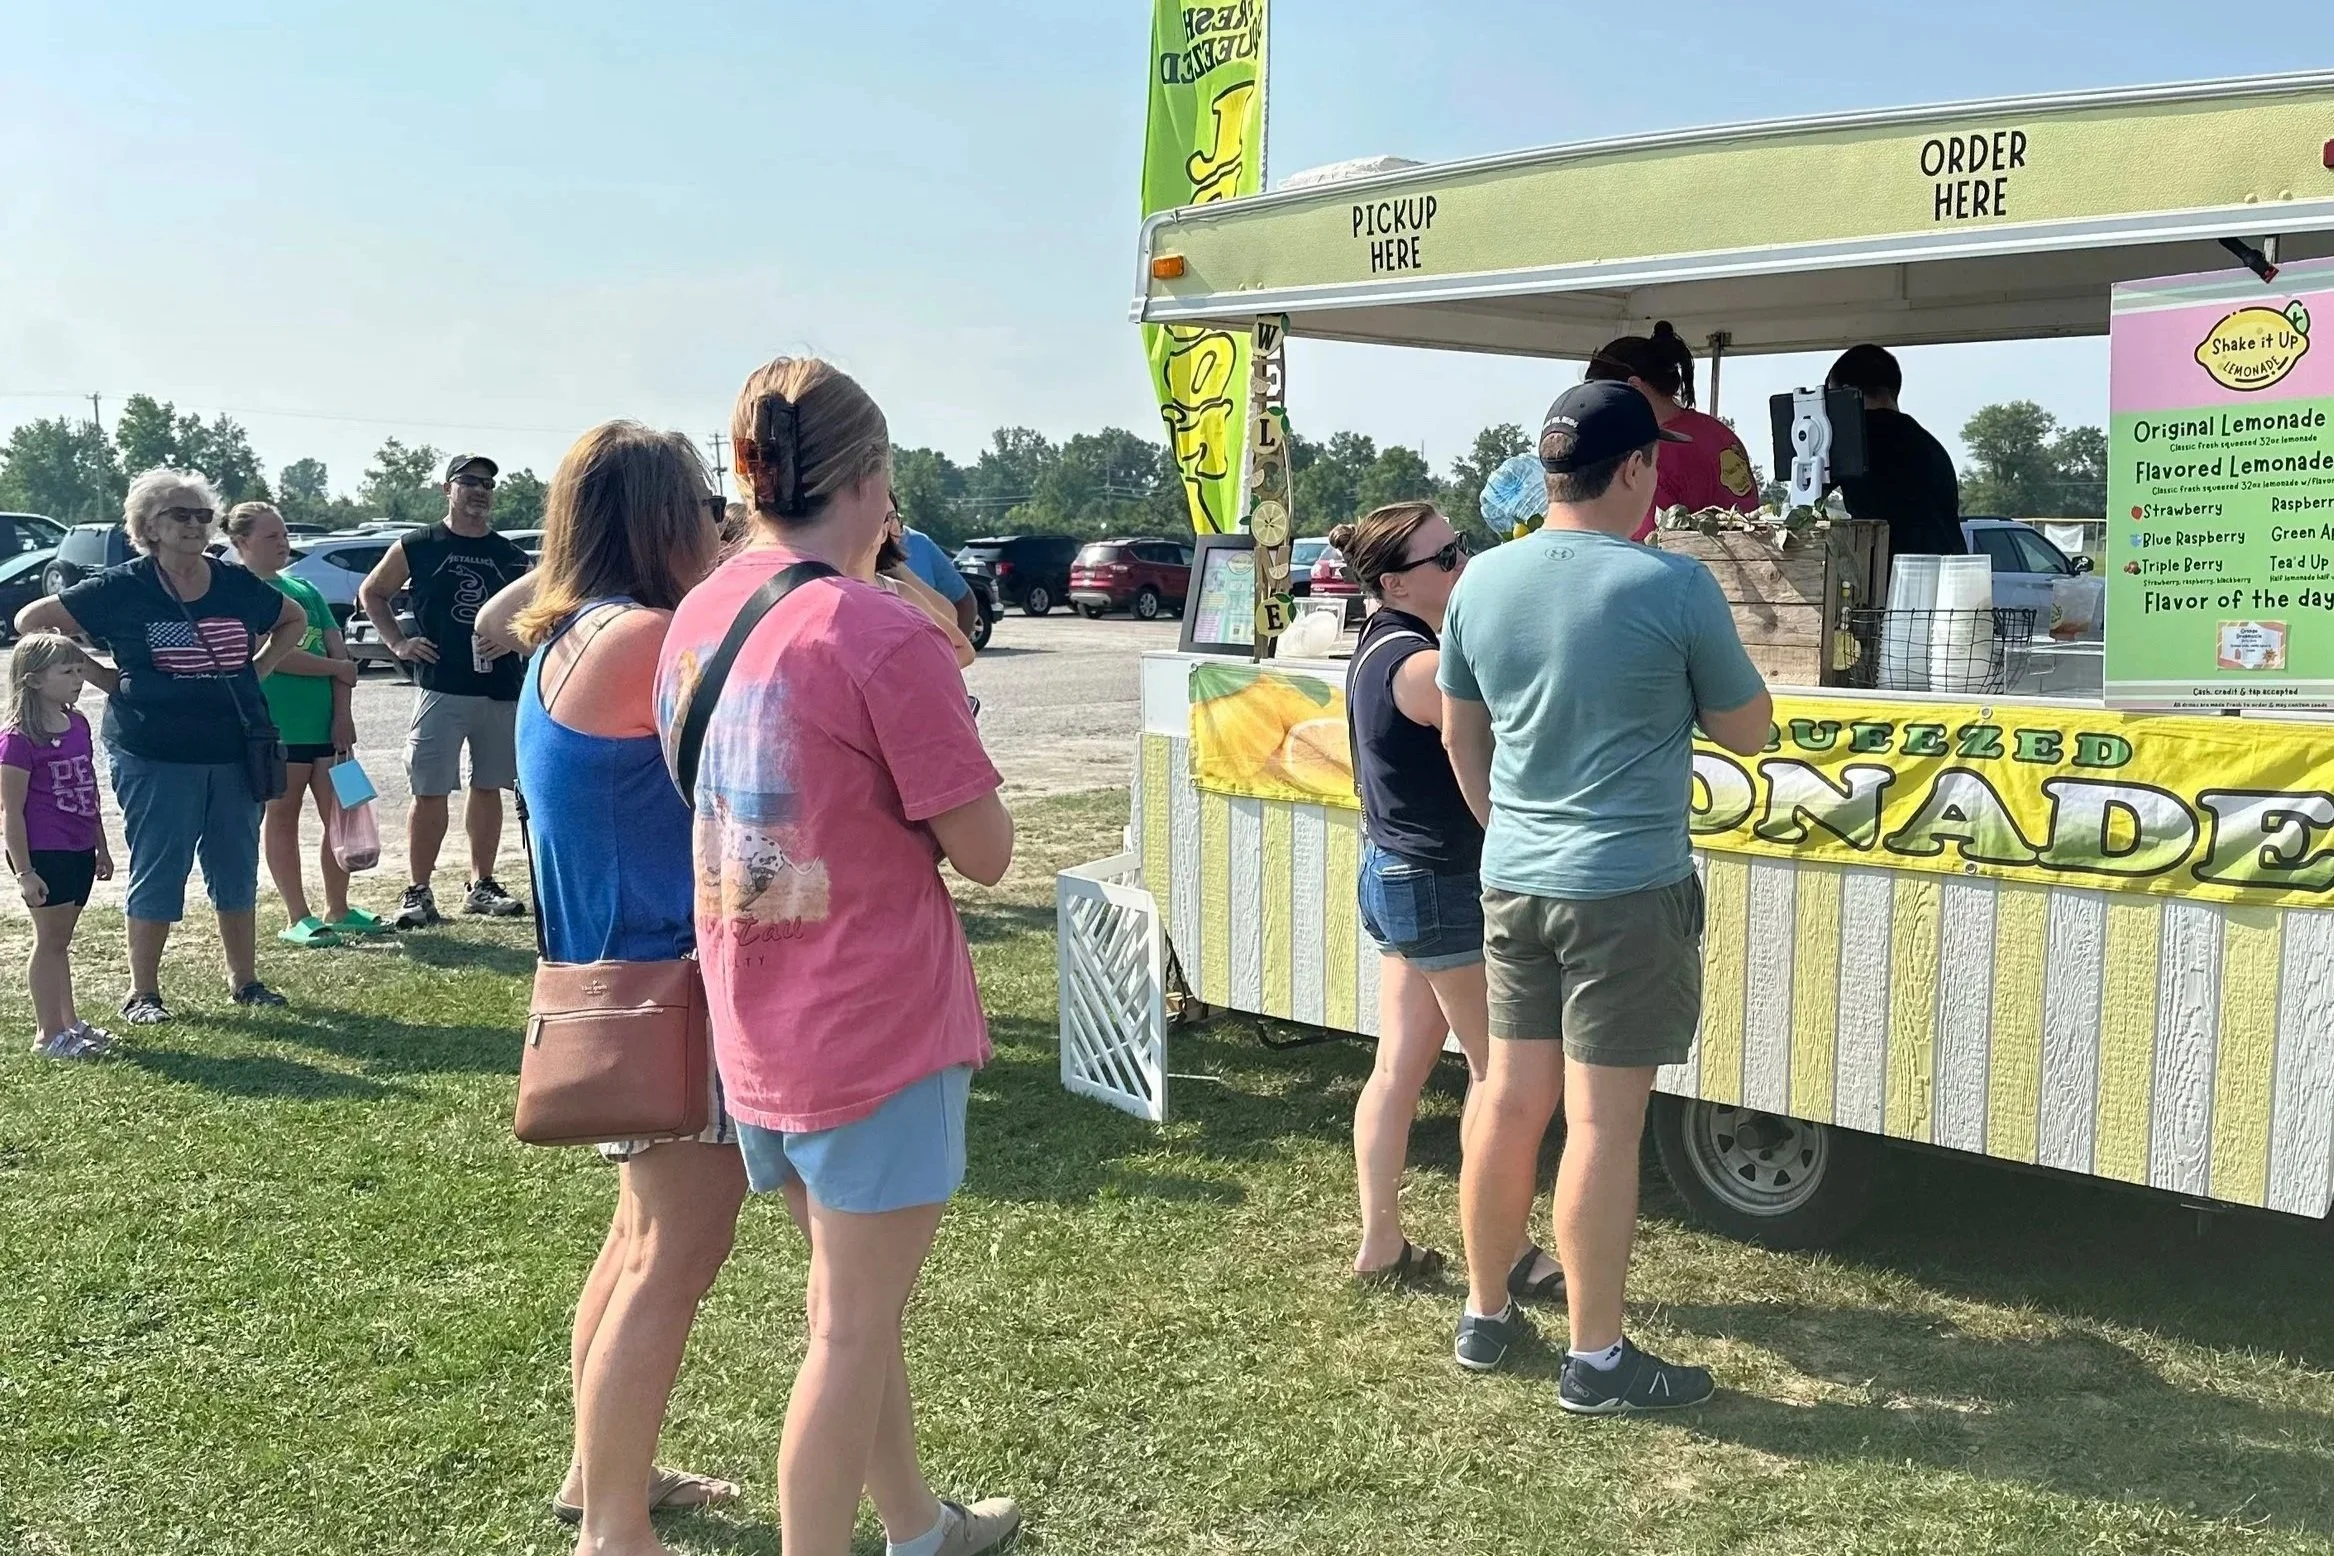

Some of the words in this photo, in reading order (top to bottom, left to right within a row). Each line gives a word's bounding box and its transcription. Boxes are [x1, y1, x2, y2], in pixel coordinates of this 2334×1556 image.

[1920, 130, 2027, 177] ORDER
[1935, 177, 2008, 222] HERE
[1353, 195, 1437, 239] PICKUP
[1371, 236, 1422, 273] HERE
[2212, 336, 2256, 355] Shake
[2261, 333, 2274, 349] it
[2223, 356, 2280, 377] LEMONADE
[2134, 416, 2214, 443] Original
[2221, 408, 2326, 437] Lemonade
[2170, 443, 2196, 452] Classic
[2198, 440, 2219, 450] fresh
[2220, 438, 2257, 449] squeezed
[2259, 437, 2279, 447] 32oz
[2281, 434, 2317, 444] lemonade
[2136, 457, 2222, 484] Flavored
[2229, 450, 2334, 478] Lemonade
[2152, 486, 2178, 496] Classic
[2180, 484, 2201, 493] fresh
[2203, 482, 2239, 493] squeezed
[2241, 481, 2261, 490] 32oz
[2263, 480, 2299, 489] lemonade
[2143, 503, 2223, 519] Strawberry
[2143, 532, 2172, 549] Blue
[2176, 530, 2246, 547] Raspberry
[2271, 526, 2316, 542] Green
[2142, 558, 2180, 575] Triple
[2184, 557, 2224, 573] Berry
[2270, 554, 2306, 572] Tea'd
[2310, 554, 2329, 571] Up
[2216, 577, 2252, 585] blackberry
[2284, 574, 2316, 582] lemonade
[2145, 591, 2209, 614] Flavor
[2217, 589, 2244, 609] of
[2251, 588, 2289, 609] the
[2298, 587, 2334, 611] day
[2214, 688, 2238, 696] credit
[2249, 688, 2261, 697] tap
[2262, 688, 2299, 697] accepted
[1693, 719, 2133, 769] UEEZED
[1690, 750, 2334, 889] ONADE
[731, 915, 804, 947] Tail
